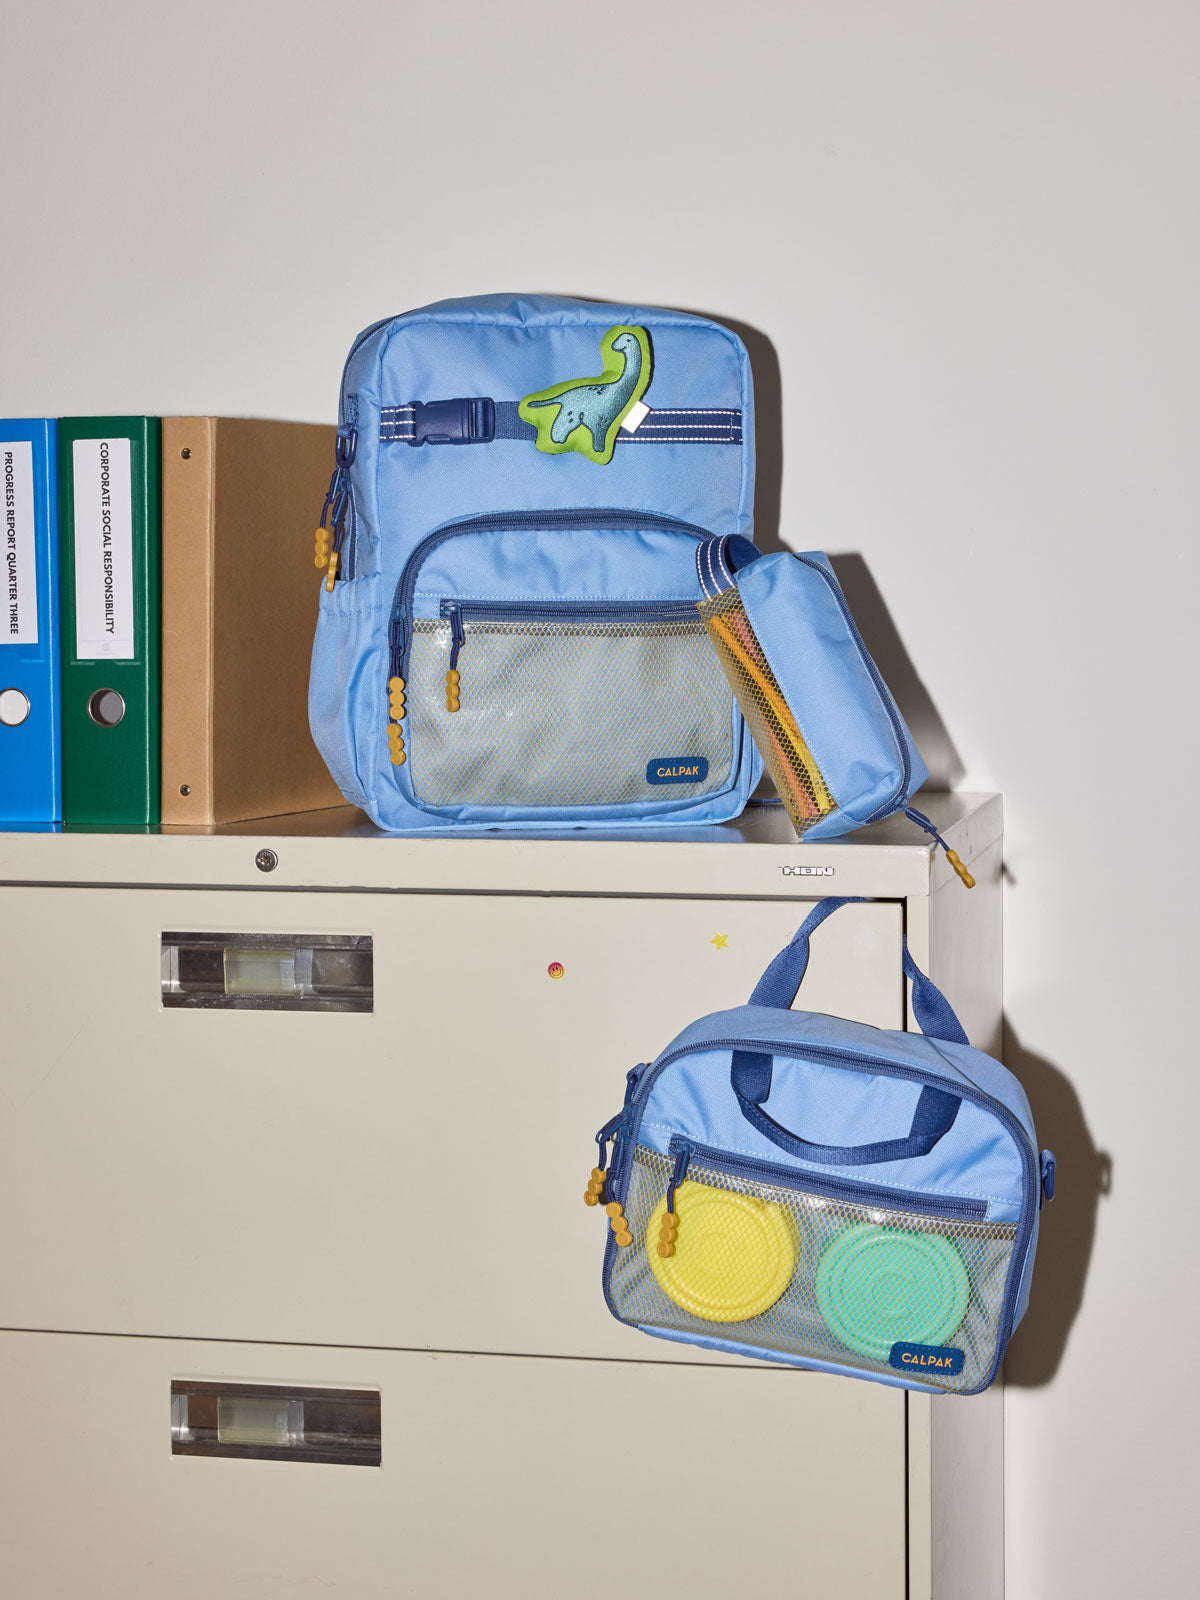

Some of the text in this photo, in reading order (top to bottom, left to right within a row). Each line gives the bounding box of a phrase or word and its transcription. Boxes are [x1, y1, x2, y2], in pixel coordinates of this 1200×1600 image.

[4, 451, 19, 635] PROGRESS REPORT QUARTER THREE
[99, 442, 115, 634] CORPORATE SOCIAL RESPONSIBILITY
[656, 765, 699, 777] CALPAK
[901, 1352, 953, 1368] CALPAK
